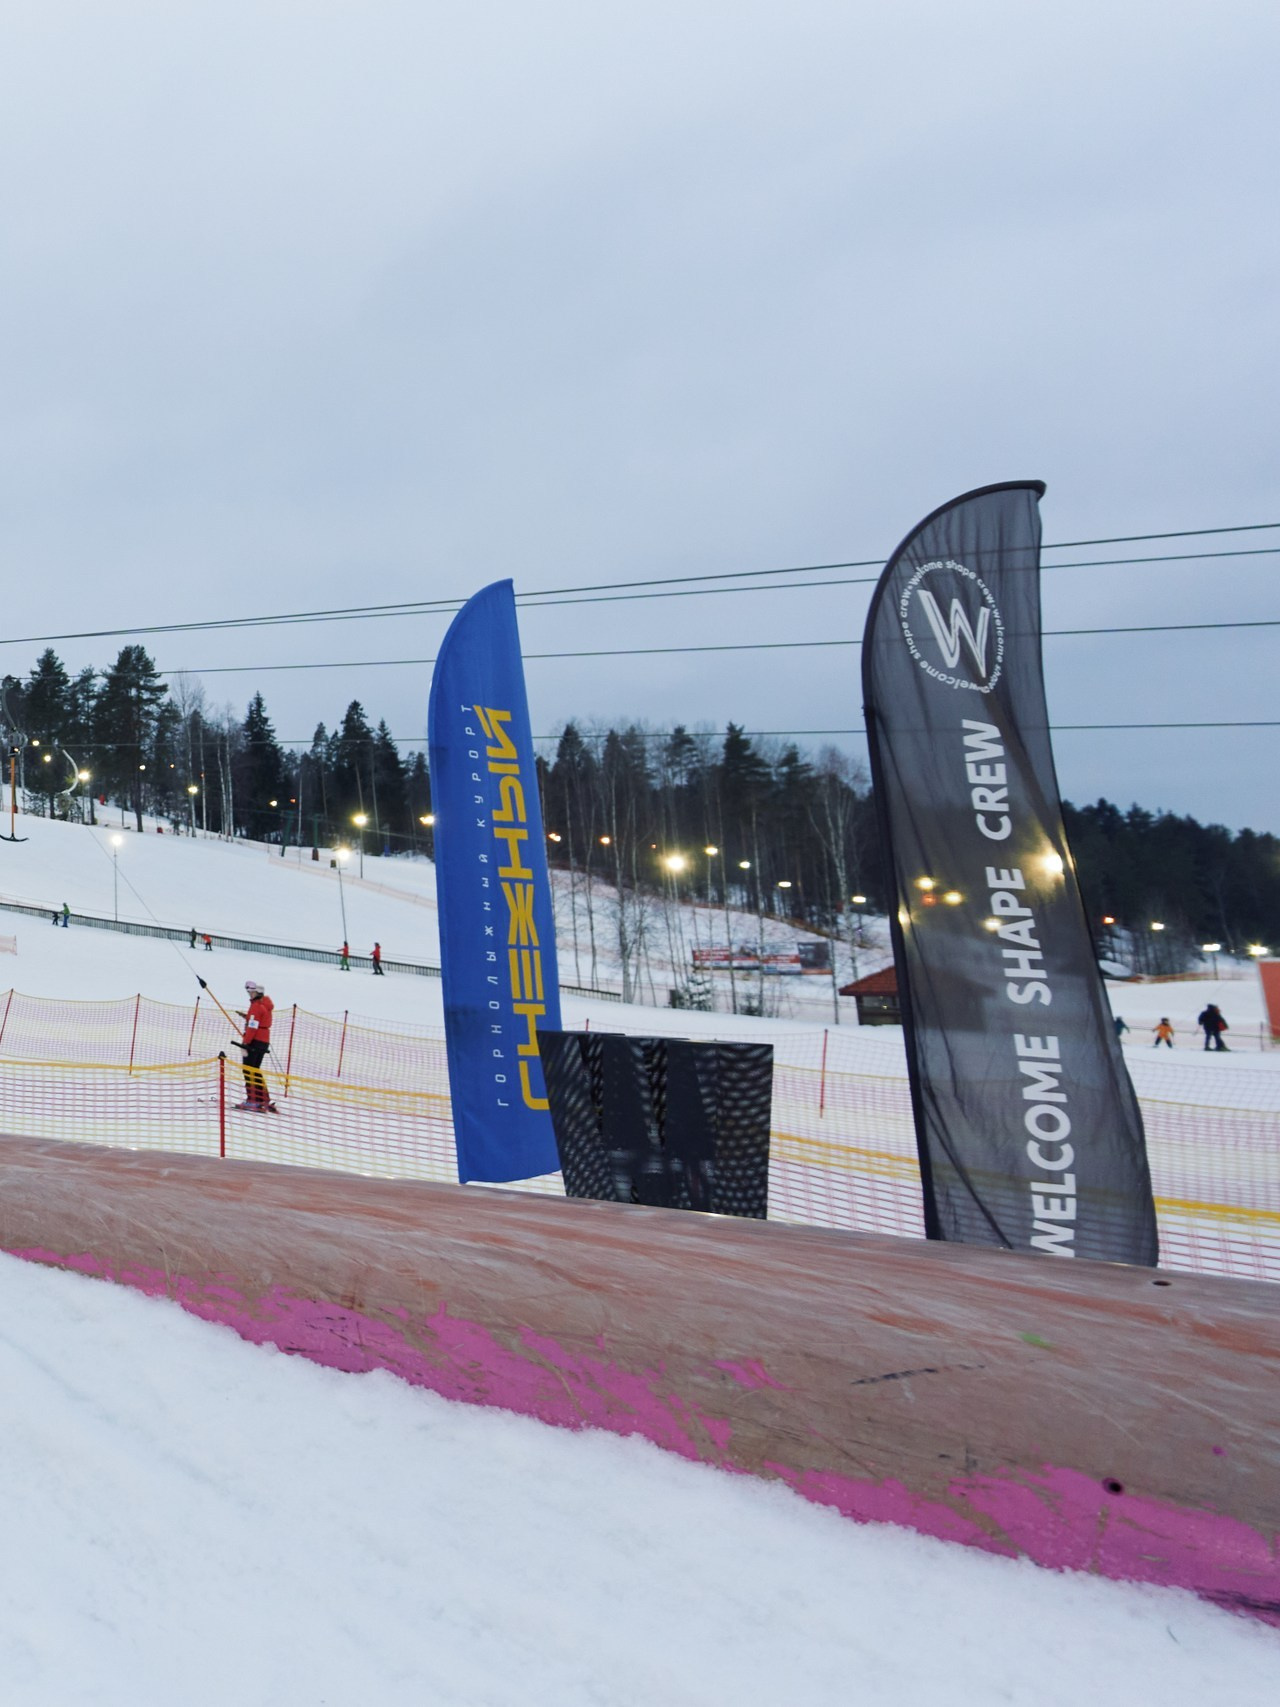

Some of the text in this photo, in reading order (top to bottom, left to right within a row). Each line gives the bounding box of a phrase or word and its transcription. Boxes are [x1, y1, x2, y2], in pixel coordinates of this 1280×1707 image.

[945, 560, 976, 580] shape
[900, 590, 912, 618] crew
[977, 579, 995, 604] crew
[901, 621, 921, 660] shape
[992, 608, 1005, 663] welcome
[461, 704, 509, 1107] ГОРНОЛЫЖНЫЙ КУРОРТ
[962, 719, 1078, 1258] WELCOME SHAPE CREW
